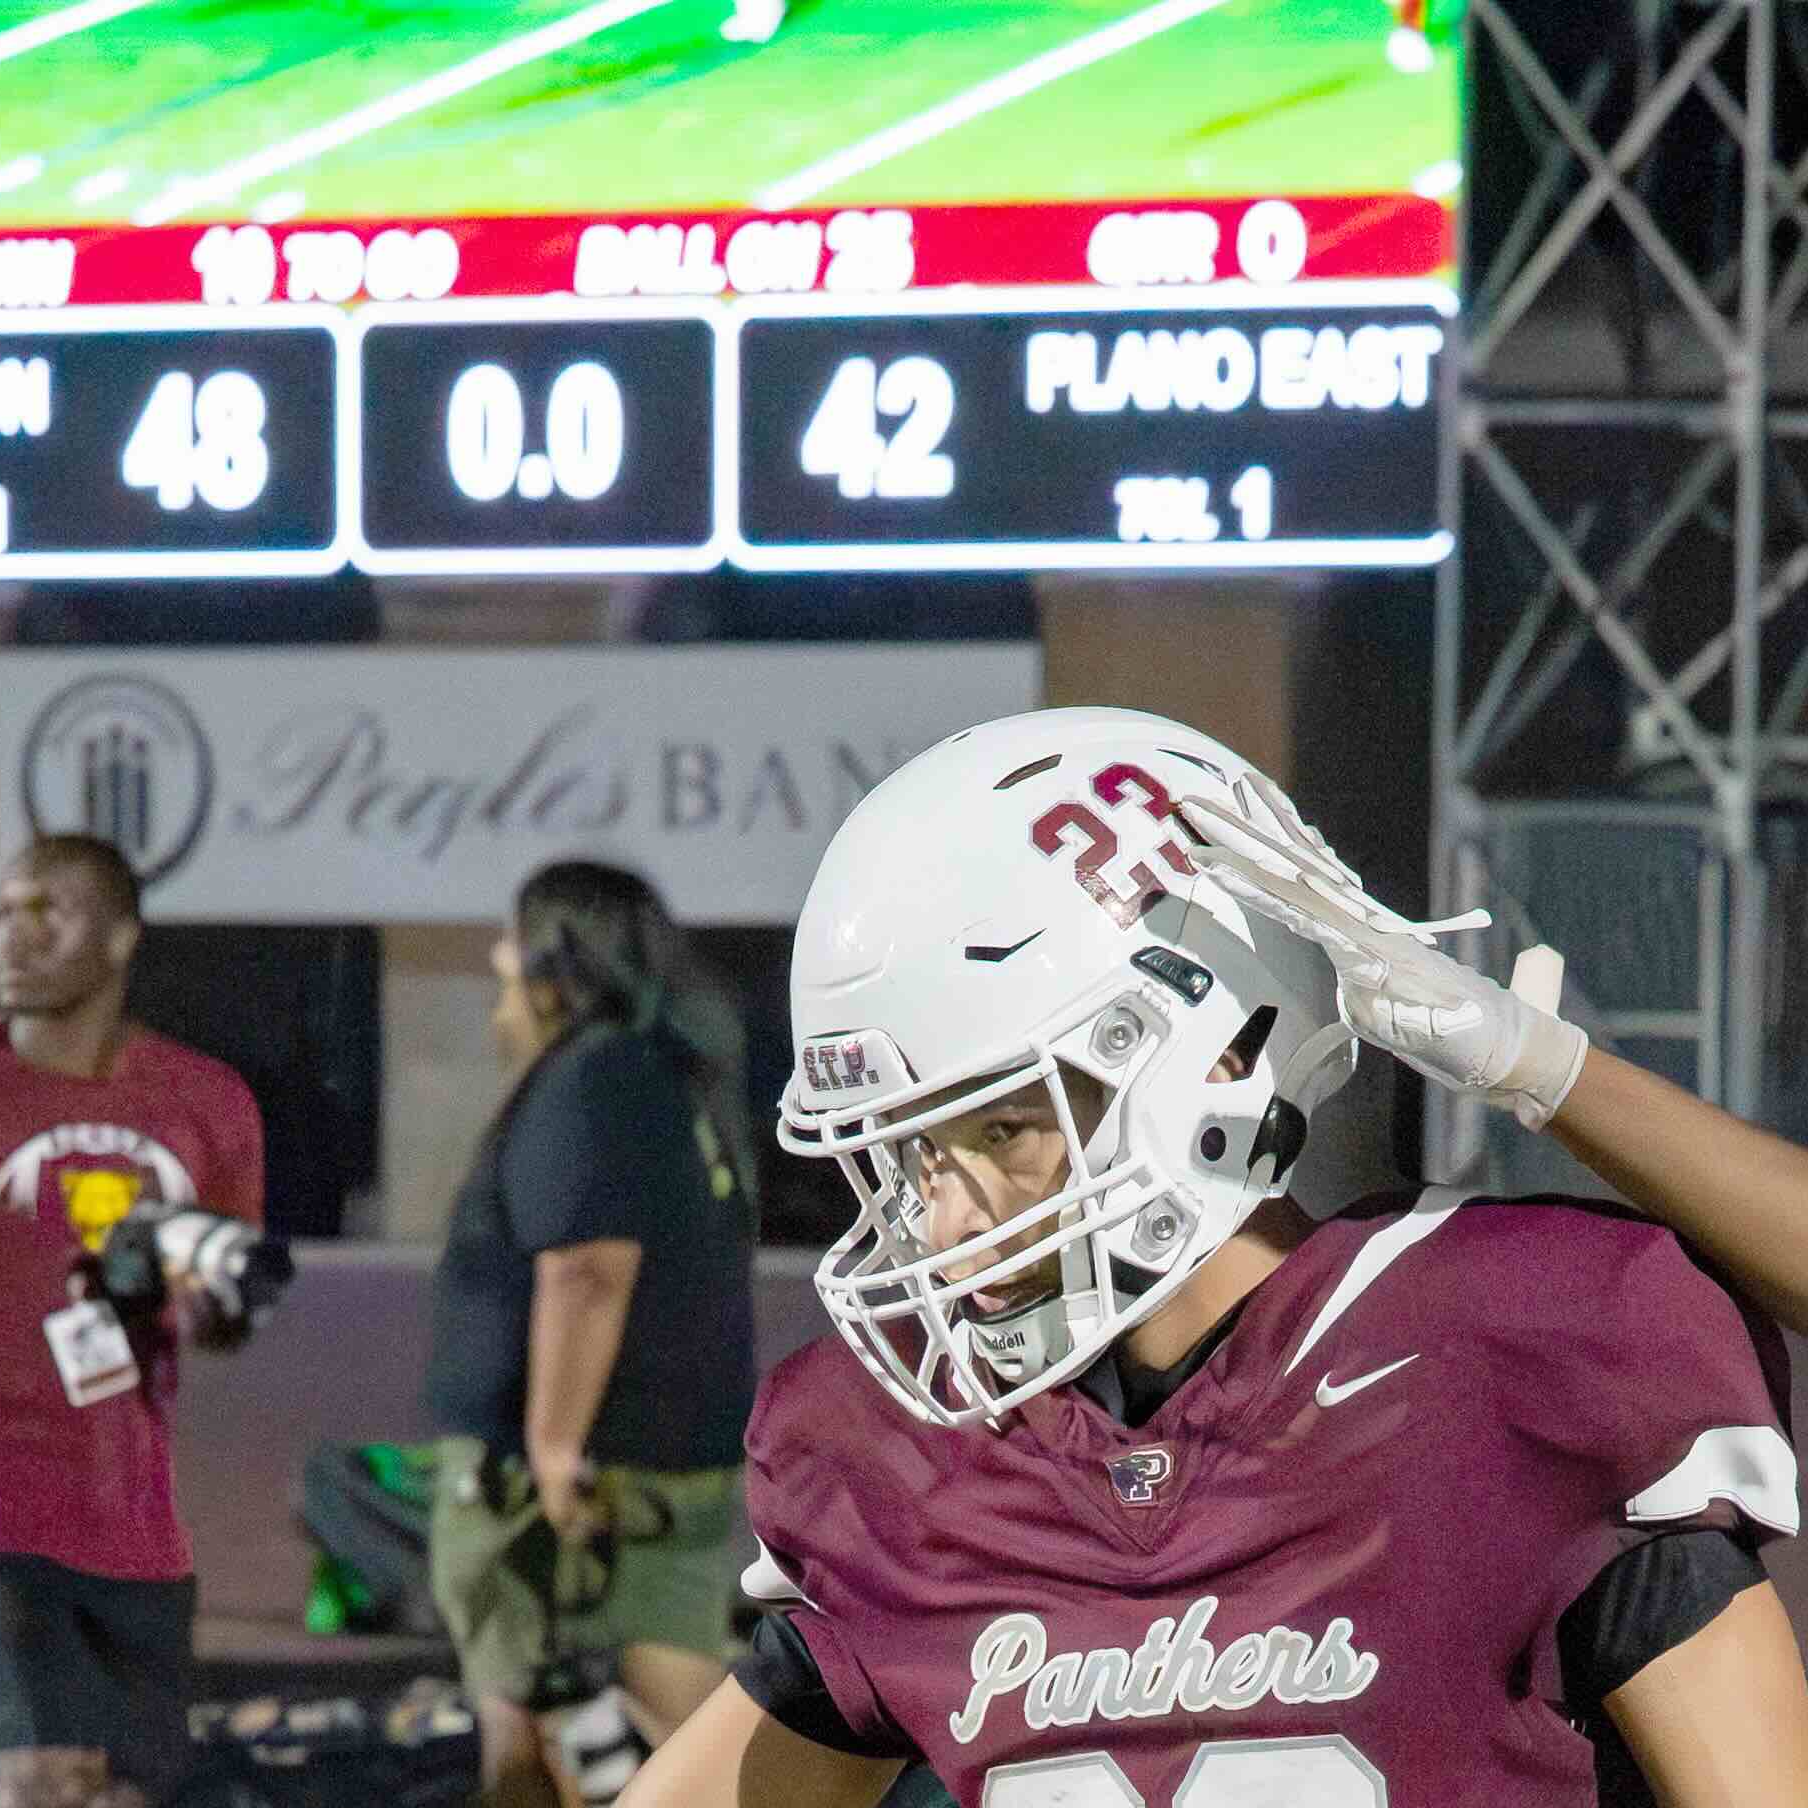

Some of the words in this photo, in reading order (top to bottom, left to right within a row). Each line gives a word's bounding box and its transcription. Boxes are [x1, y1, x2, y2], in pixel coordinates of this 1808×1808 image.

[576, 227, 726, 294] BALL
[1240, 201, 1304, 285] 0
[1029, 330, 1253, 411] PLANO
[1262, 327, 1441, 408] EAST
[125, 373, 266, 508] 48
[447, 362, 622, 501] 0.0
[800, 356, 955, 499] 42
[1233, 468, 1270, 539] 1
[657, 740, 905, 834] BAN
[1026, 762, 1199, 932] 23
[949, 1594, 1380, 1744] Panthers
